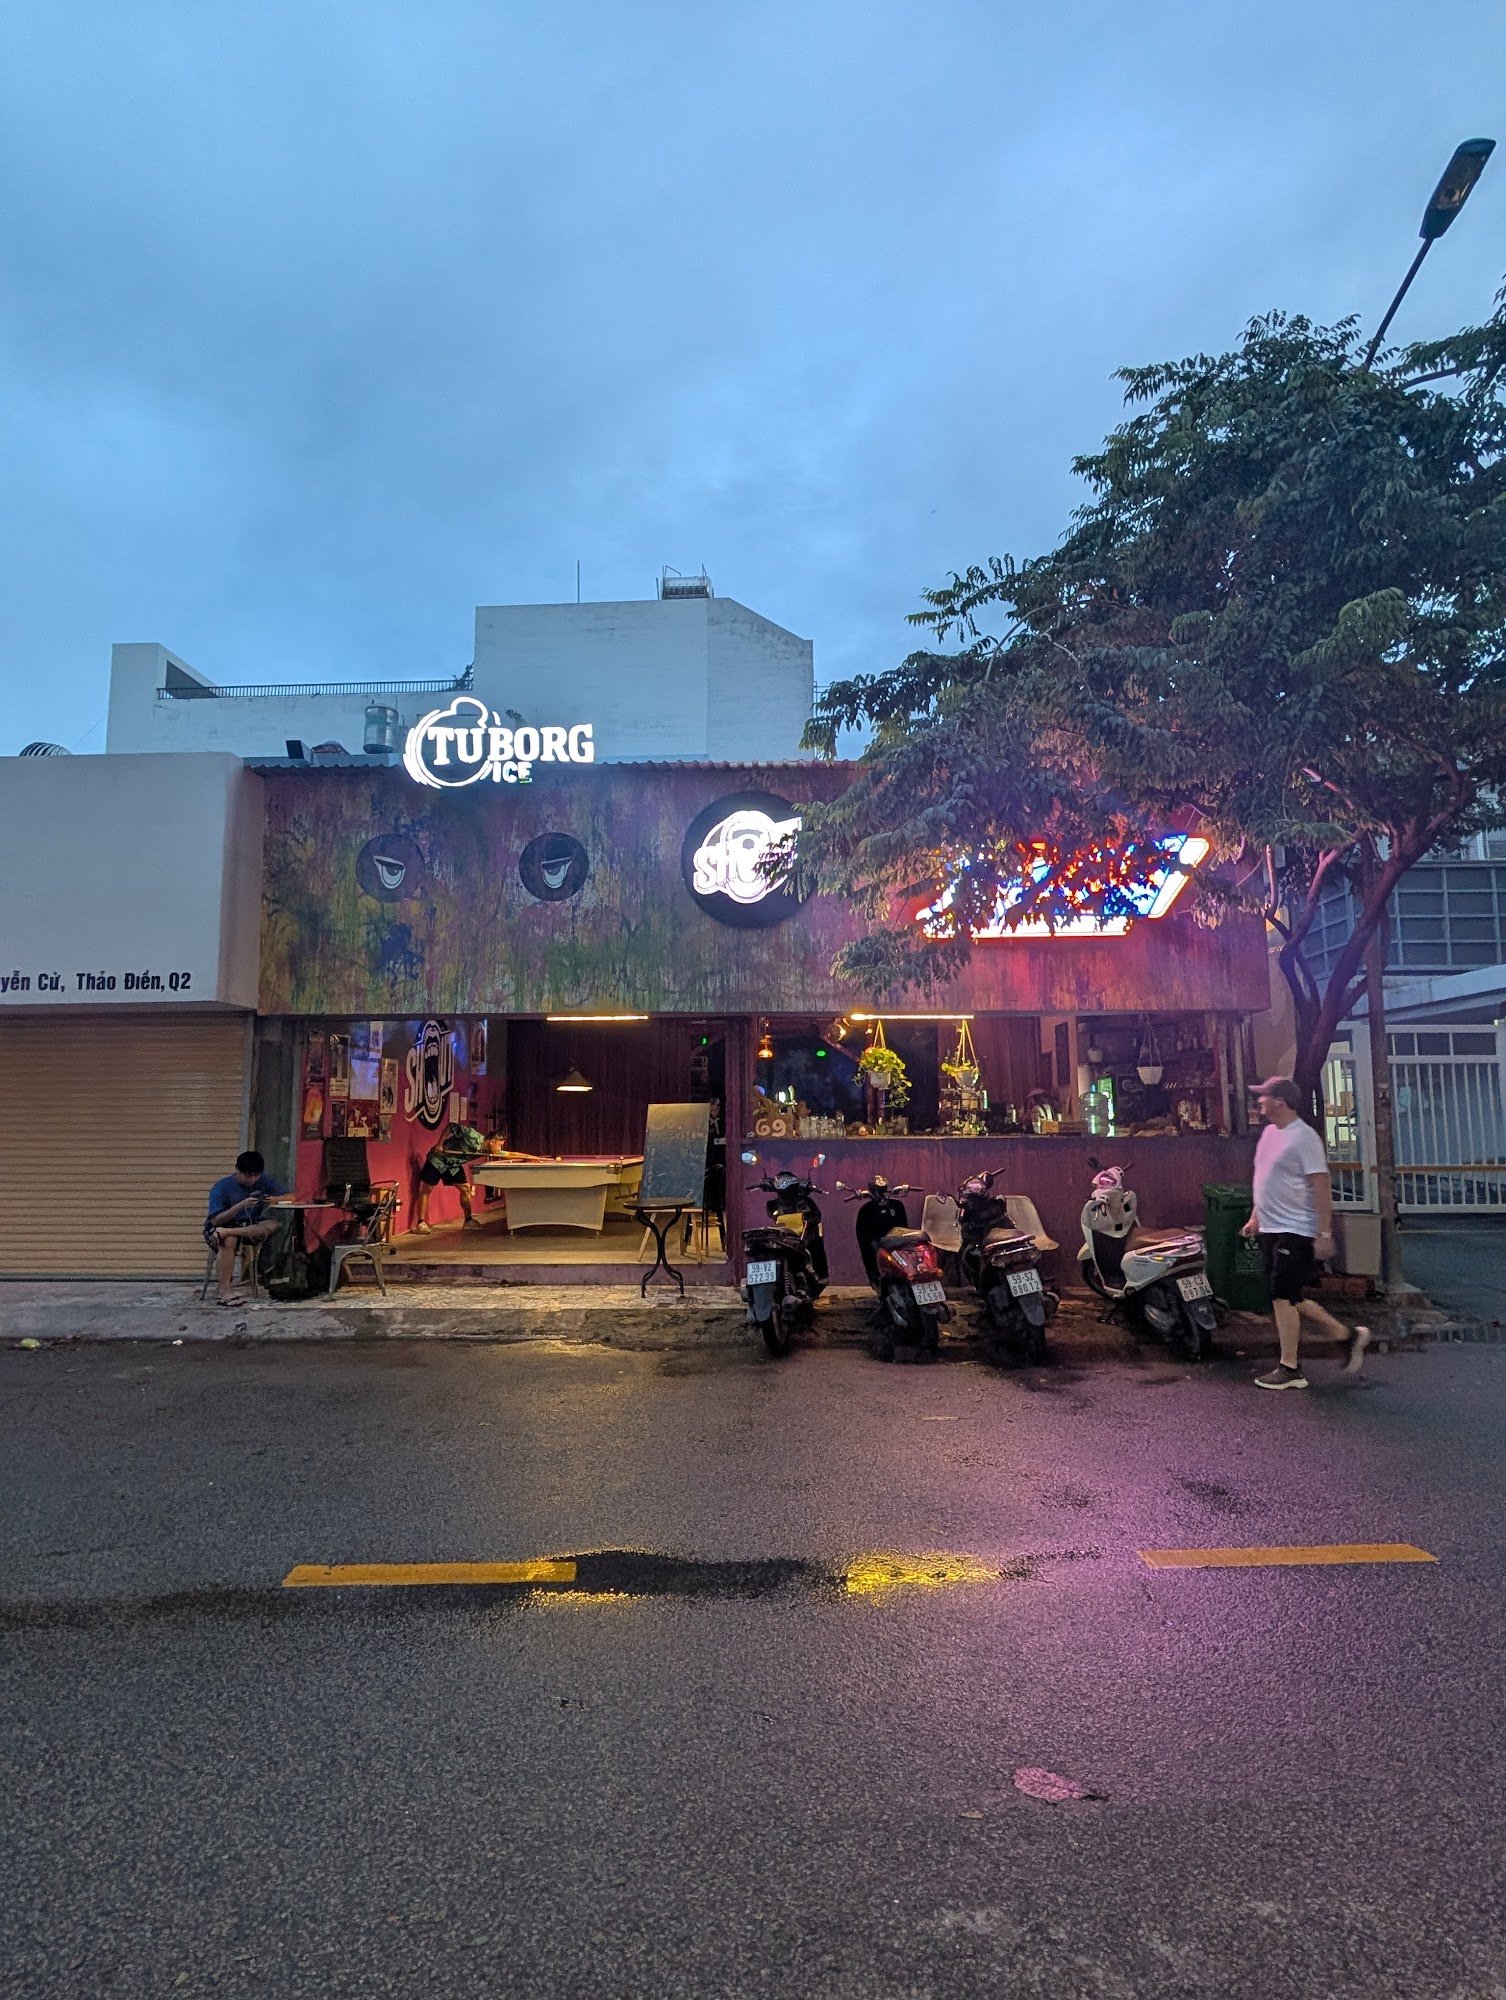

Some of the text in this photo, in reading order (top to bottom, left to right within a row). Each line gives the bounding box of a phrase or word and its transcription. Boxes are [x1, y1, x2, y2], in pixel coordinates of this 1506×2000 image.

[427, 724, 595, 766] TUBORG
[491, 761, 533, 784] ICE
[76, 970, 116, 990] Thảo
[168, 972, 191, 991] Q2
[755, 1118, 787, 1137] 69
